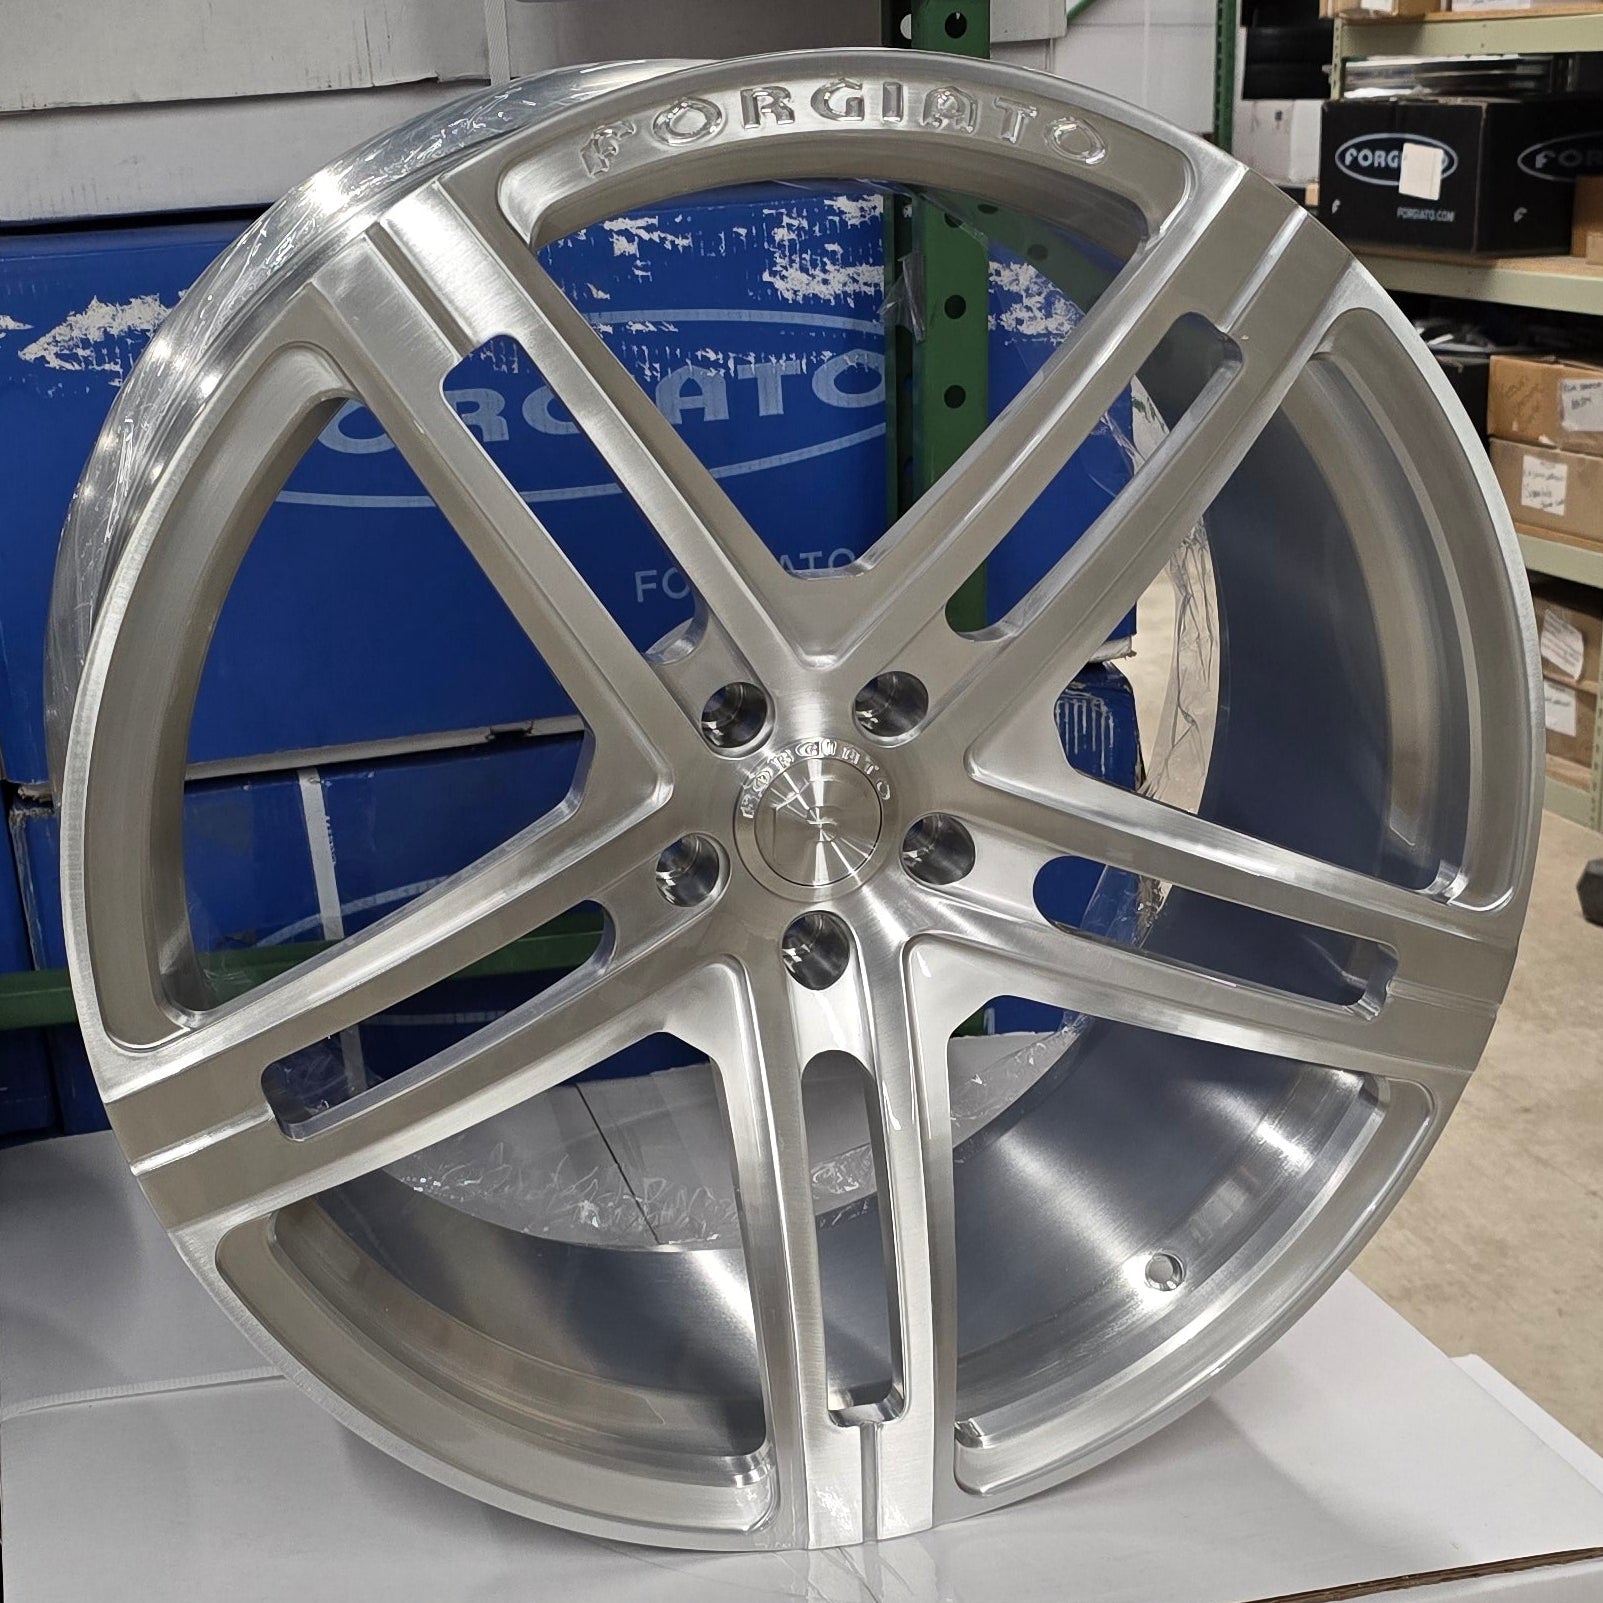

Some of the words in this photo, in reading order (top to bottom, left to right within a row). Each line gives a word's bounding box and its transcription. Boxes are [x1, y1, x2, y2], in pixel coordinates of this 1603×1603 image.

[580, 77, 1108, 177] FORGIATO
[1344, 148, 1449, 168] FORG
[1397, 206, 1455, 222] FORGIATO.COM
[741, 739, 891, 819] FORGIATO
